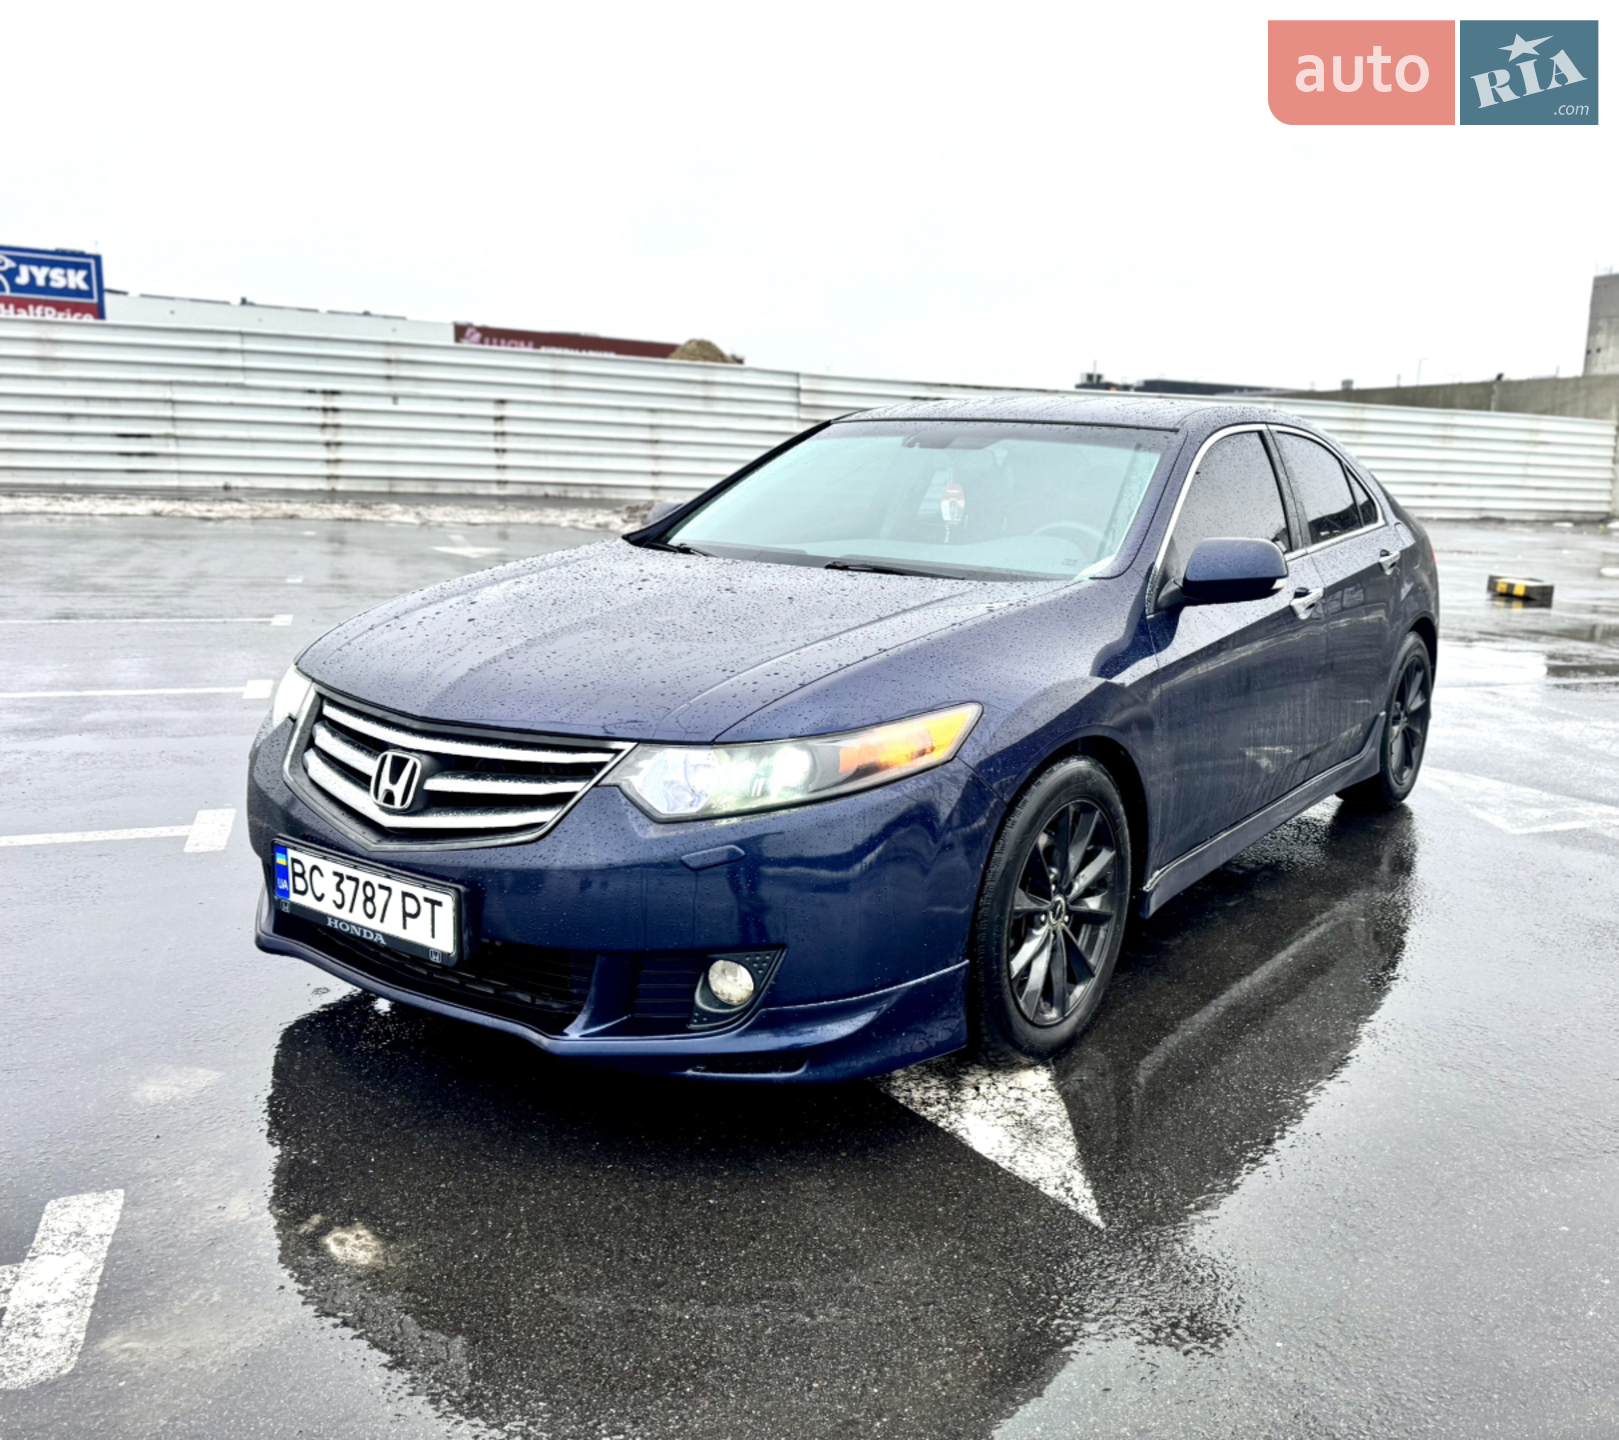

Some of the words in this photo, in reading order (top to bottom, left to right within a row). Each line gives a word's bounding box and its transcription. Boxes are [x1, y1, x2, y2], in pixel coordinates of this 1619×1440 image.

[15, 264, 90, 291] JYSK
[277, 877, 289, 891] UA
[290, 857, 325, 902] BC
[332, 871, 393, 924] 3787
[401, 890, 444, 940] PT
[326, 916, 387, 945] HONDA
